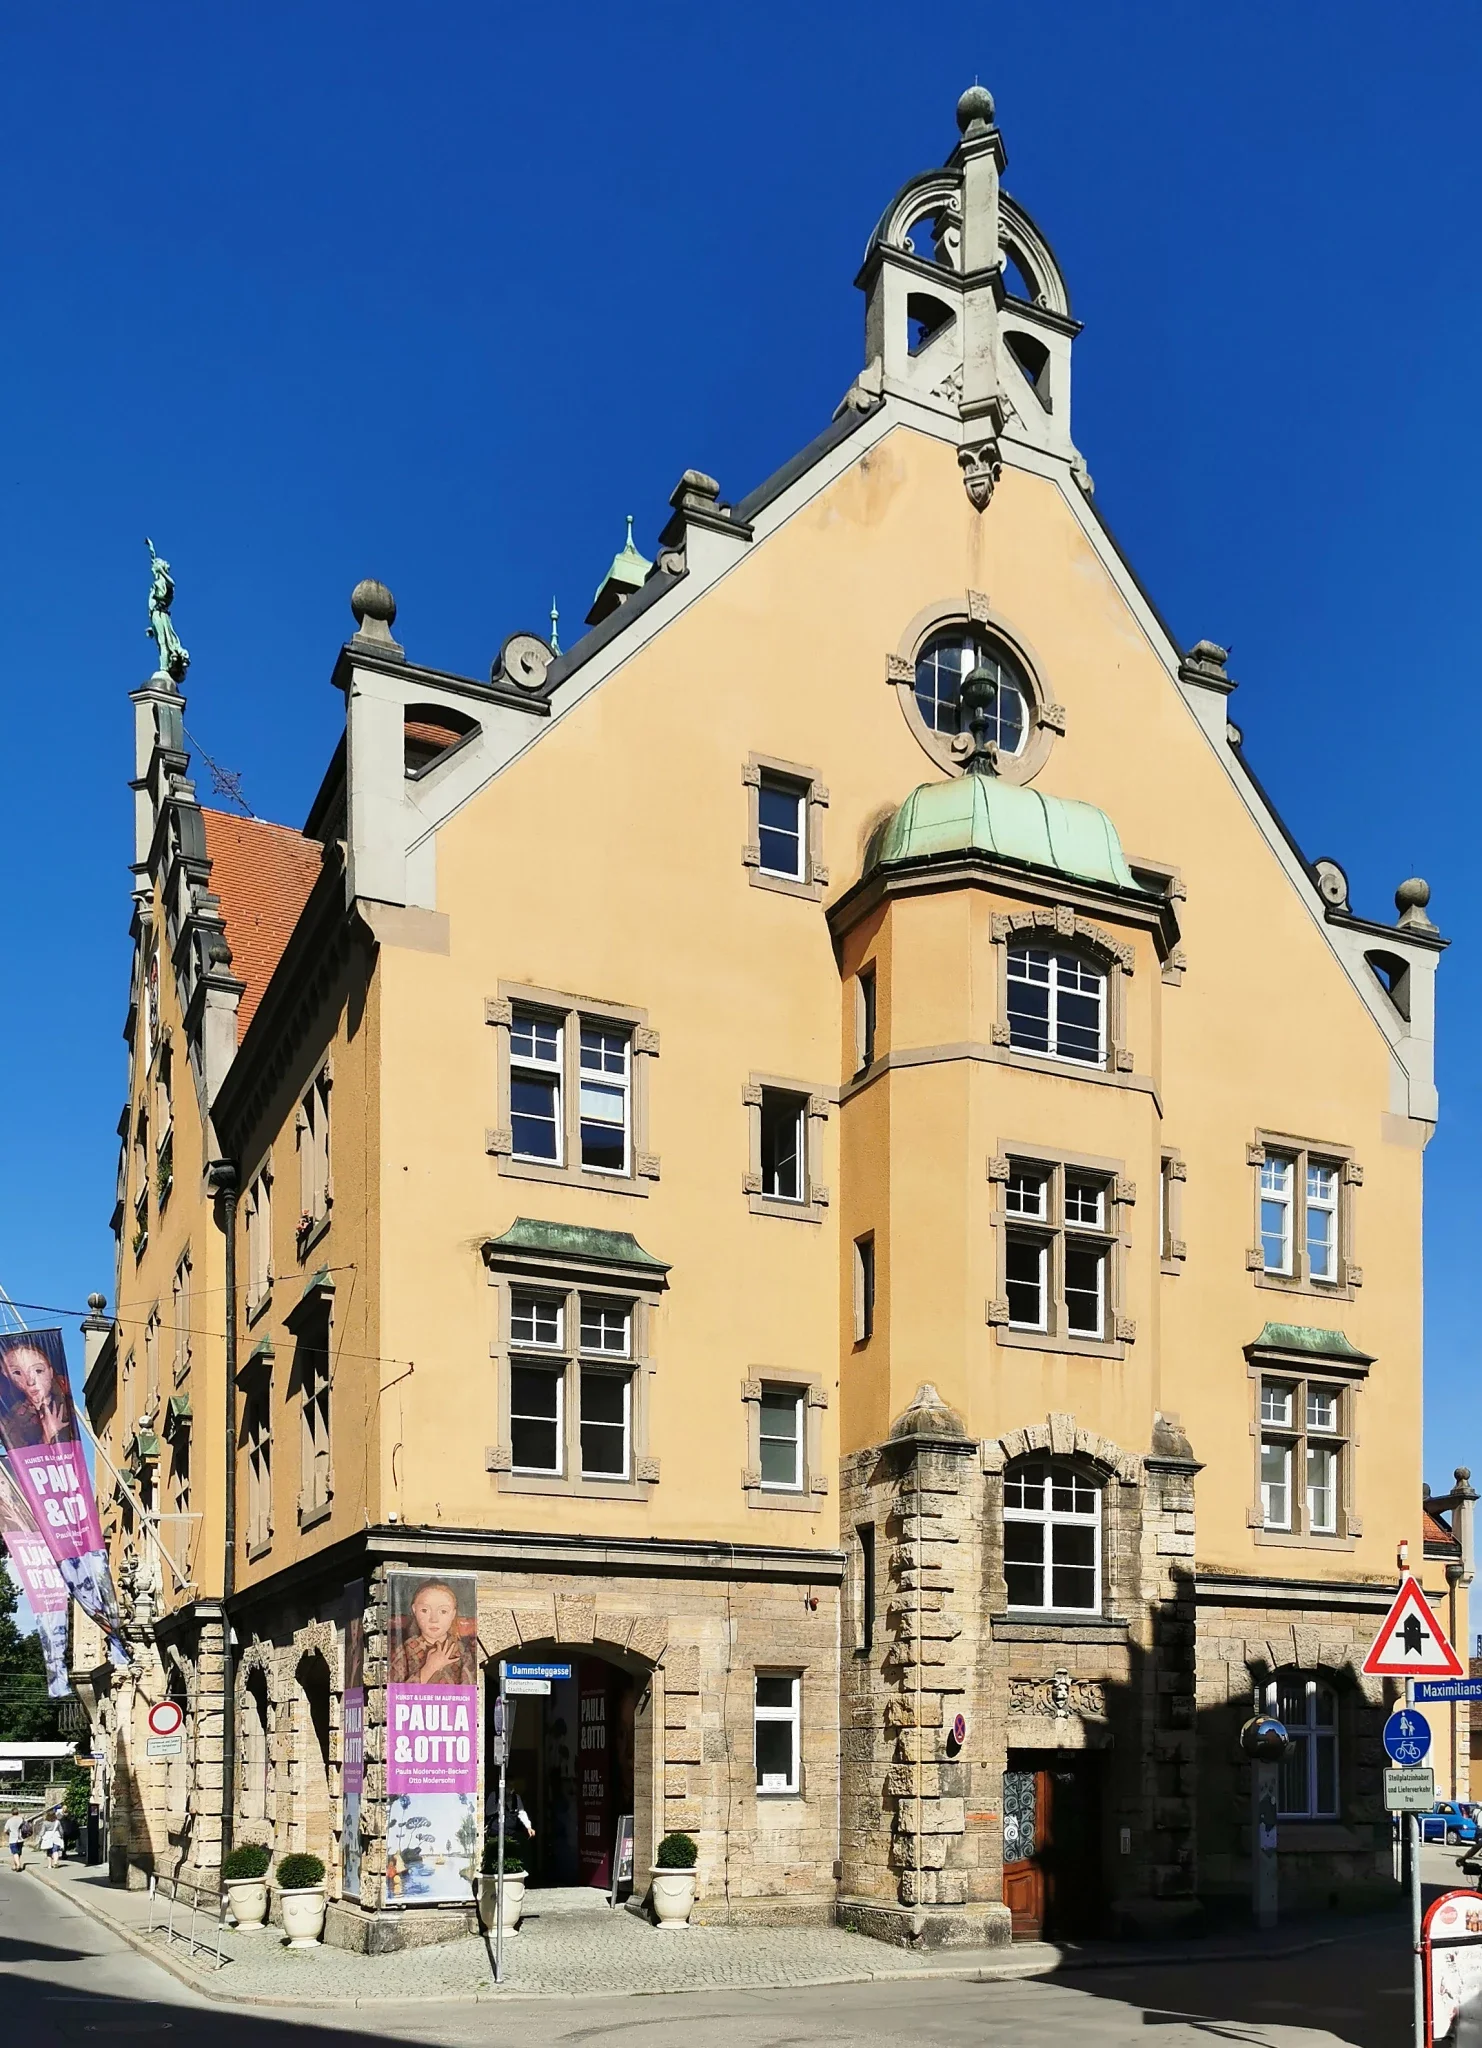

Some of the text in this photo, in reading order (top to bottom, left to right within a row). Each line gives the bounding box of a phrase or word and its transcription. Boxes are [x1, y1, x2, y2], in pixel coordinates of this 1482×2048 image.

[512, 1665, 569, 1678] Dammsteggasse
[1423, 1682, 1482, 1698] Maximilians
[442, 1694, 470, 1702] AUFBRUCH
[581, 1697, 606, 1722] PAULA
[395, 1703, 470, 1732] PAULA
[1388, 1774, 1429, 1783] Stellplatzinhaber
[1397, 1786, 1431, 1794] Lieferverkehr
[1405, 1795, 1414, 1803] frei
